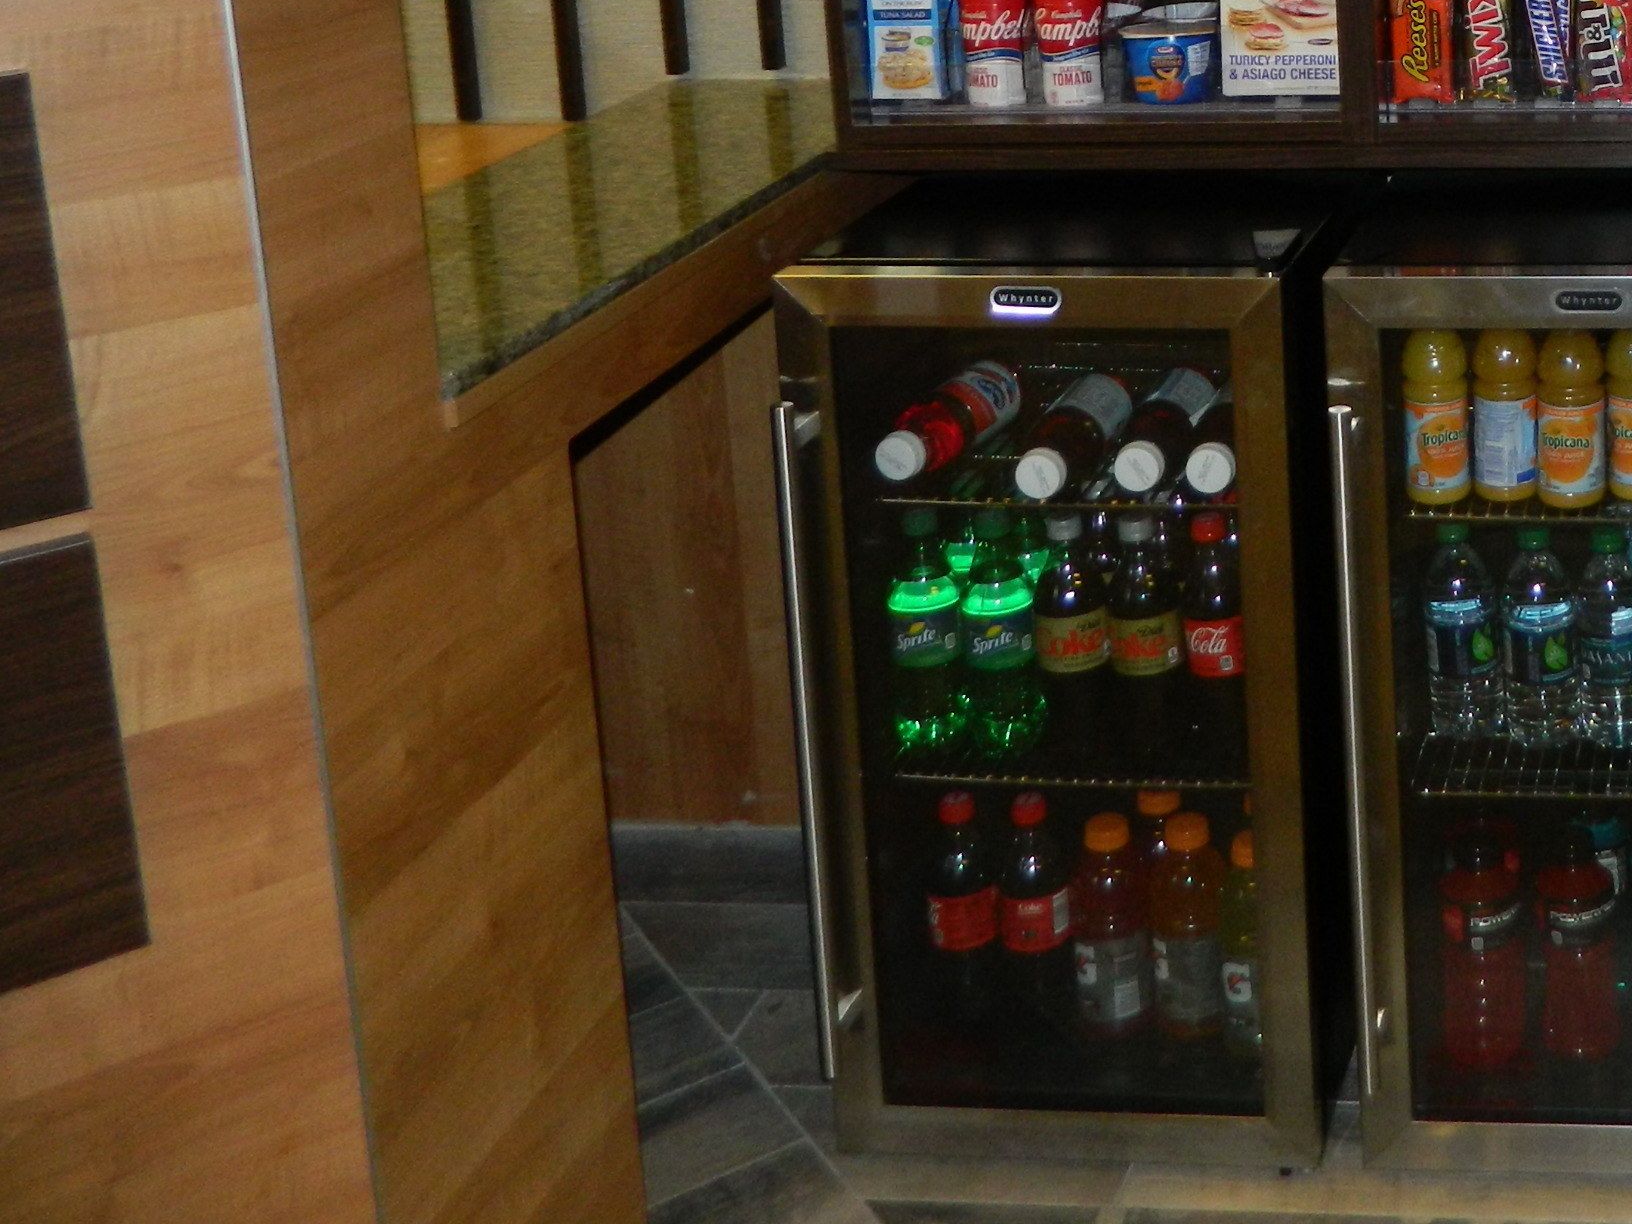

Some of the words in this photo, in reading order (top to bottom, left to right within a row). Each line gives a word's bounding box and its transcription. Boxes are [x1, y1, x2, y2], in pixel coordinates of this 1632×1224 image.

[1229, 54, 1271, 66] TURKEY
[1274, 54, 1336, 66] PEPPERONI
[1053, 70, 1093, 87] TOMATO
[1229, 68, 1238, 80] &
[1242, 68, 1286, 80] ASIAGO
[1289, 68, 1336, 80] CHEESE
[999, 293, 1054, 304] Whynter
[897, 628, 937, 652] Sprite
[973, 631, 1013, 654] Sprite
